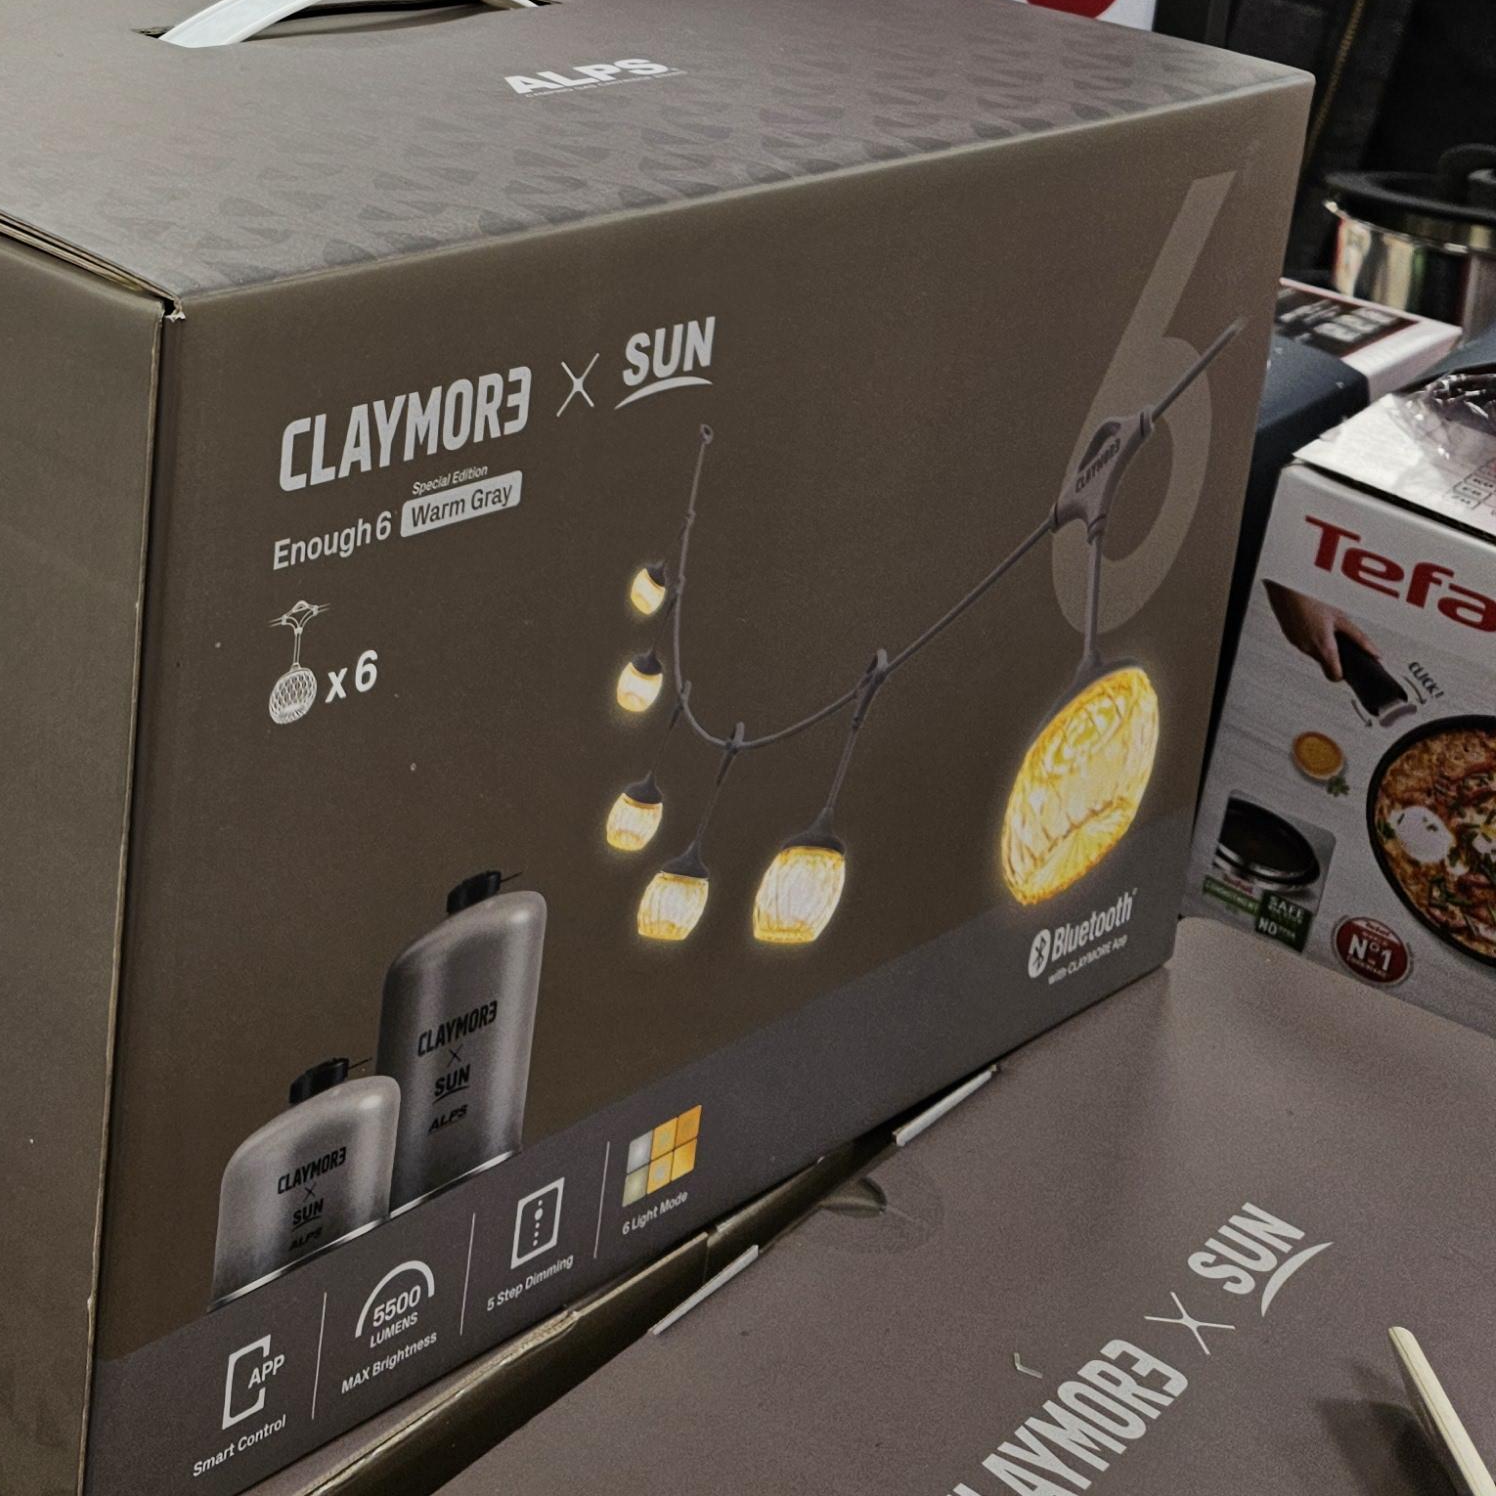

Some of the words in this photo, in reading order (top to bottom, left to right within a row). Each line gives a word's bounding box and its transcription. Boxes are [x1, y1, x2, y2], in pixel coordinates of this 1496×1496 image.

[504, 58, 669, 95] ALPS
[621, 316, 716, 388] SUN
[412, 472, 451, 496] Special
[452, 464, 489, 485] Edition
[410, 489, 466, 529] Warm
[470, 481, 513, 511] Gray
[273, 519, 373, 571] Enough
[375, 511, 393, 541] 6
[1052, 891, 1134, 963] Bluetooth
[434, 1065, 471, 1098] SUN
[428, 1104, 468, 1134] ALPS
[292, 1198, 324, 1227] SUN
[621, 1220, 632, 1235] 6
[632, 1205, 659, 1231] Light
[660, 1190, 688, 1217] Mode
[1187, 1201, 1306, 1295] SUN
[486, 1296, 496, 1312] 5
[496, 1283, 524, 1308] Step
[524, 1253, 575, 1291] Dimming
[372, 1284, 422, 1328] 5500
[370, 1312, 419, 1349] LUMENS
[247, 1354, 286, 1391] APP
[341, 1368, 370, 1395] MAX
[371, 1331, 438, 1379] Brightness
[192, 1442, 235, 1478] Smart
[237, 1415, 287, 1453] Control
